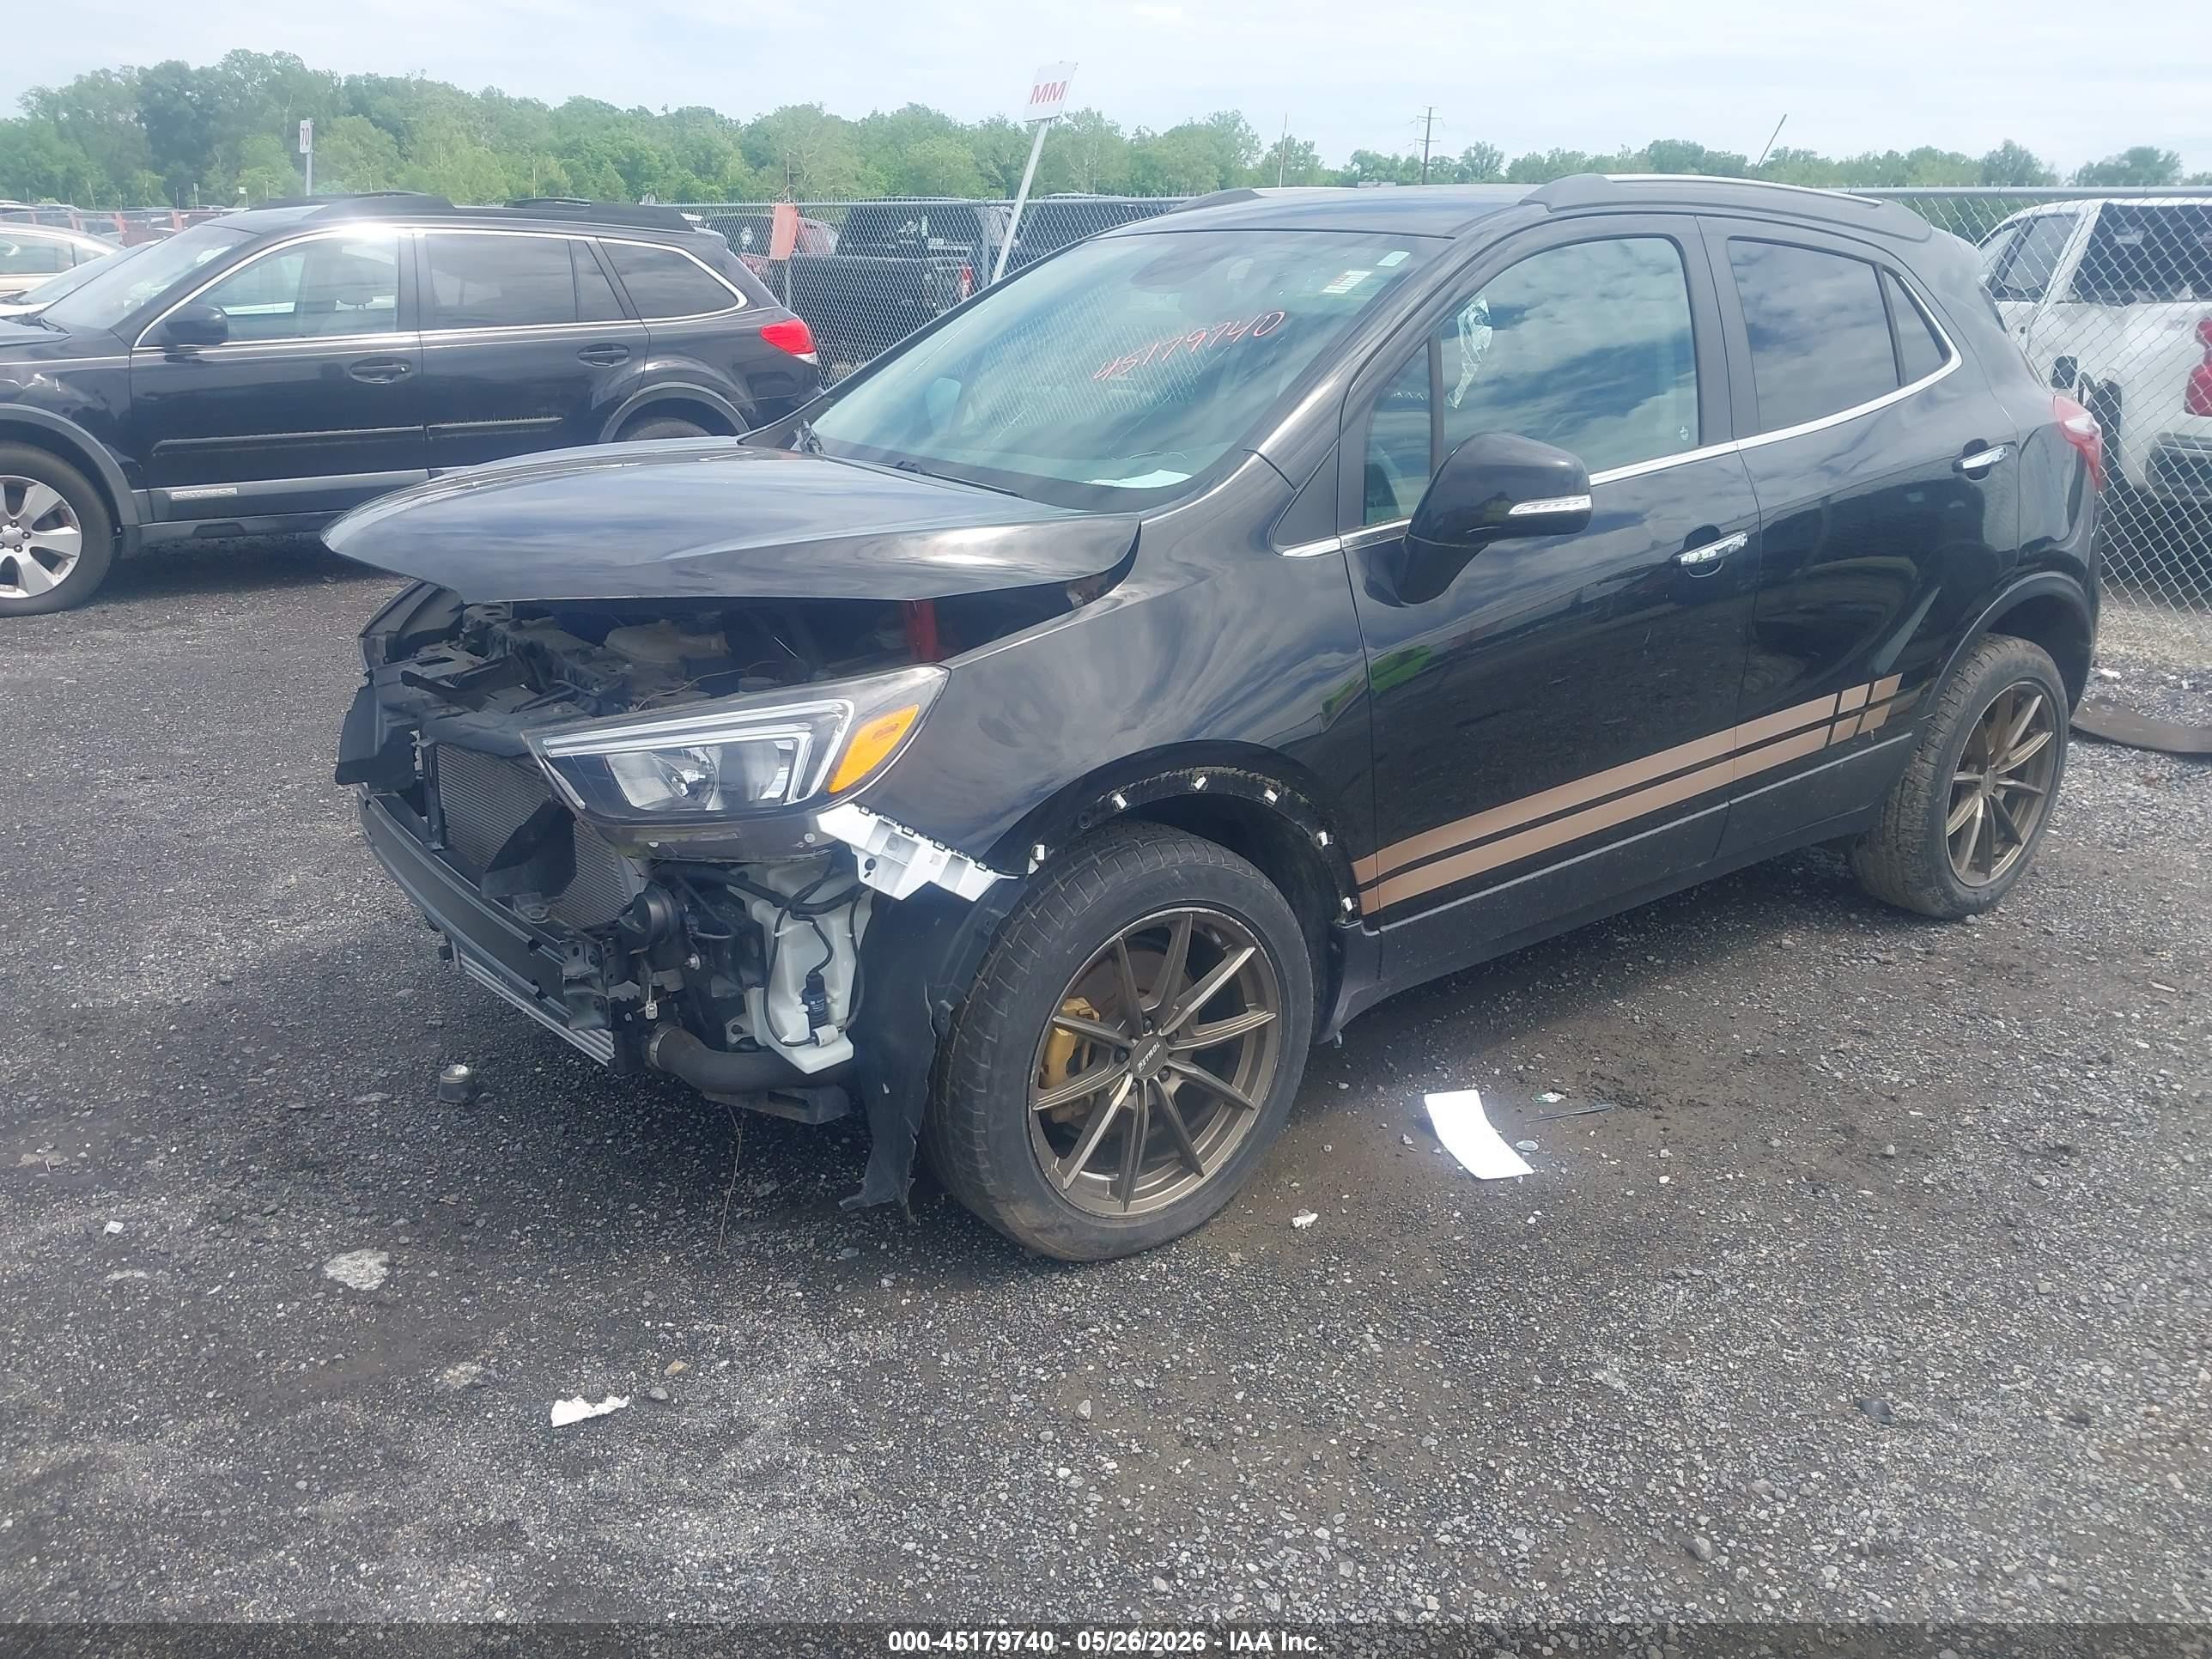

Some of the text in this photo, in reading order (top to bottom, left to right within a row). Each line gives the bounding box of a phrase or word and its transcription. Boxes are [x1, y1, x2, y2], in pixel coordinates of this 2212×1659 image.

[1030, 81, 1067, 105] MM
[301, 127, 310, 146] 70
[1093, 311, 1285, 381] 45179740
[1137, 1041, 1161, 1073] PETROL
